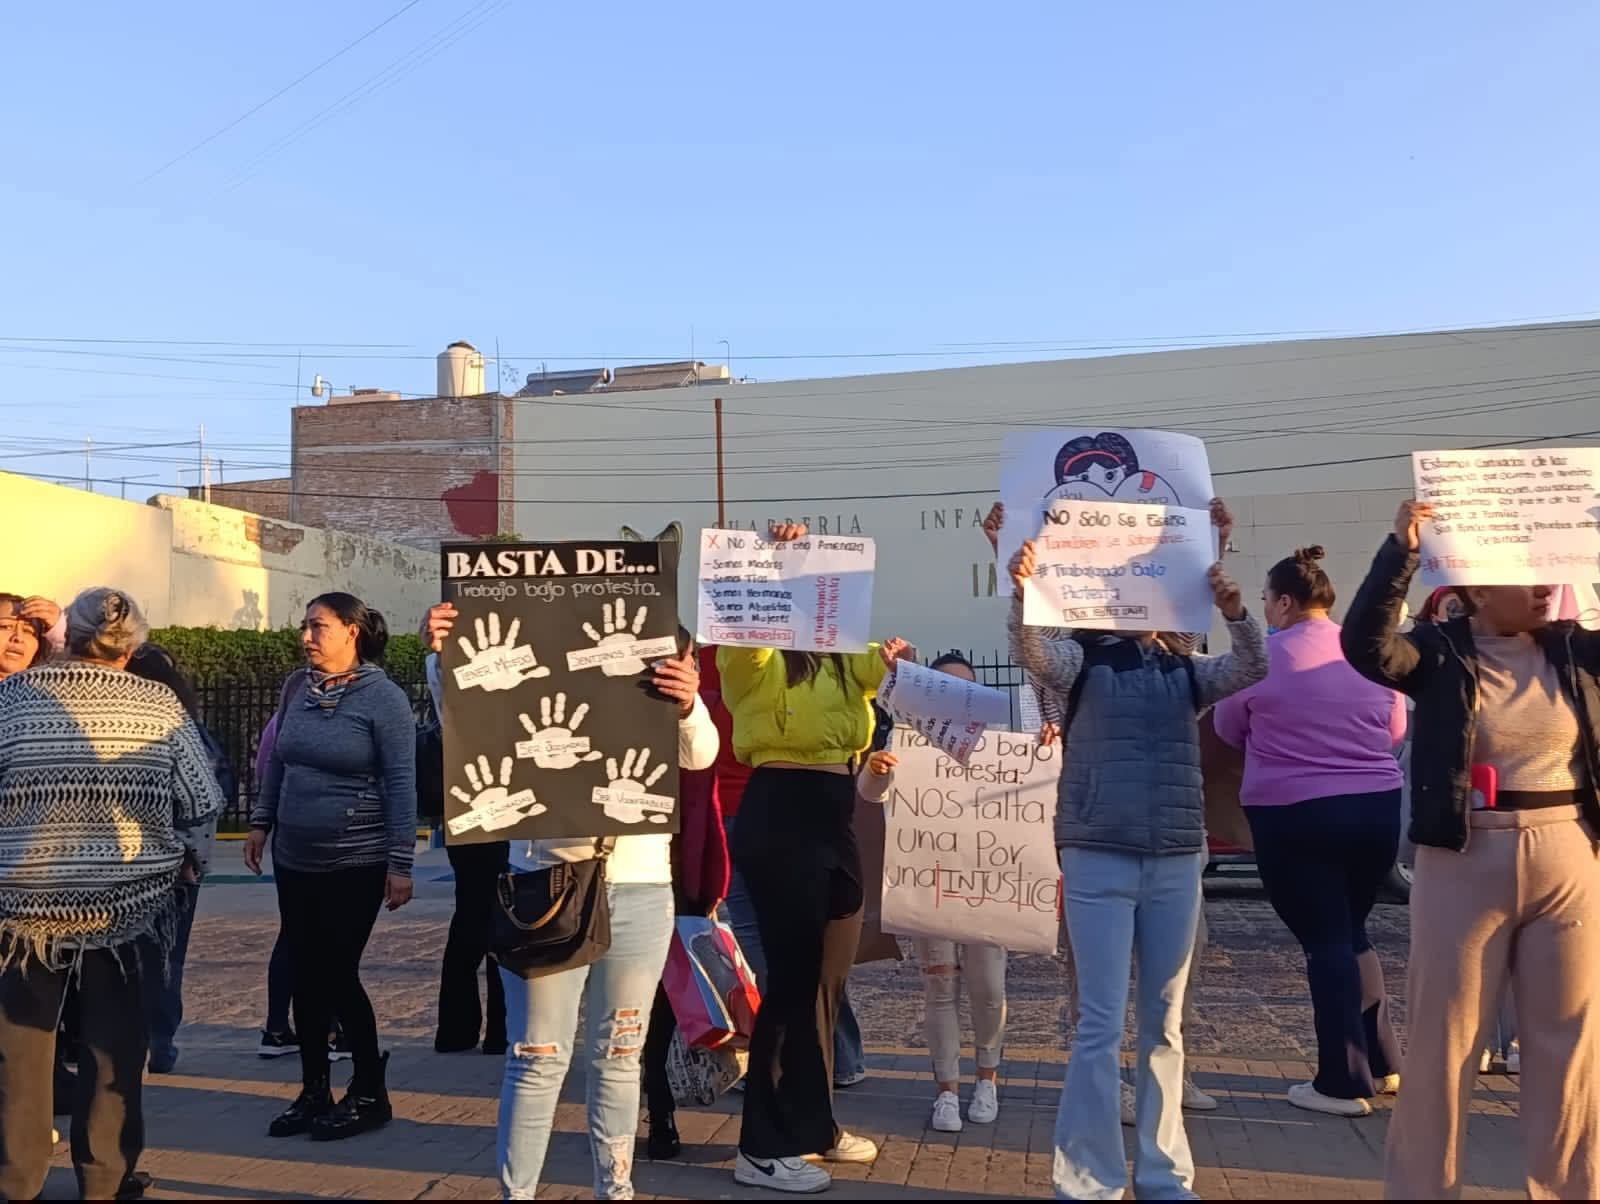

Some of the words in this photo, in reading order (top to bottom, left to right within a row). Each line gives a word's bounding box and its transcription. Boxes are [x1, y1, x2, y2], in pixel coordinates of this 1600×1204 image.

[447, 549, 567, 578] BASTA
[575, 548, 656, 574] DE...
[451, 580, 517, 601] Trabajo
[524, 580, 565, 602] bajo
[572, 578, 661, 598] protesta.
[895, 726, 986, 752] Trao
[997, 733, 1053, 775] bajo
[891, 787, 964, 819] NOS
[971, 787, 1045, 824] falta
